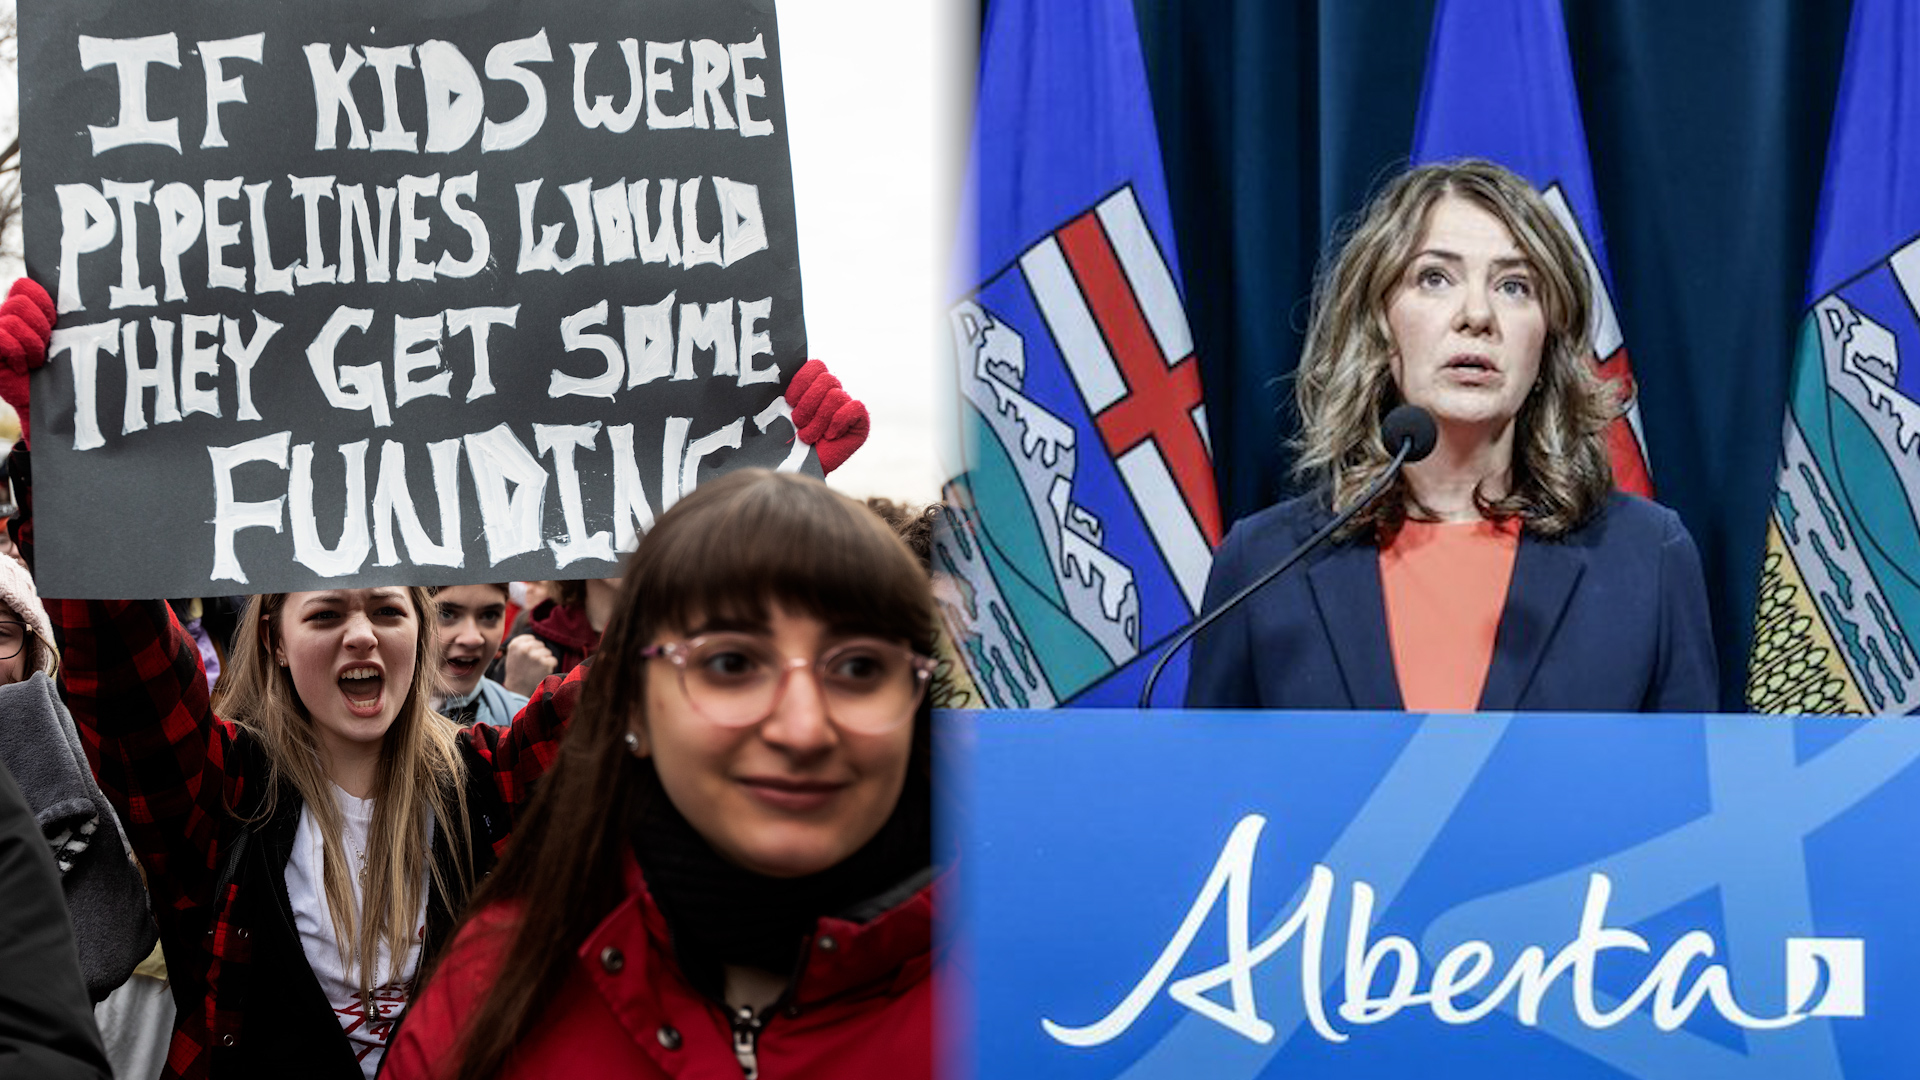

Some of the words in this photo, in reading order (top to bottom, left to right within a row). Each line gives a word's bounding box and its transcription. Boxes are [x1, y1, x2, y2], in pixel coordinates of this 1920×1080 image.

[77, 31, 266, 156] IF
[302, 26, 554, 154] KIDS
[568, 32, 775, 138] WERE
[54, 170, 491, 314] PIPELINES
[514, 175, 770, 276] WOULD
[49, 309, 284, 451] THEY
[304, 303, 522, 428] GET
[547, 289, 782, 404] SOME
[1042, 813, 1812, 1048] Alberta
